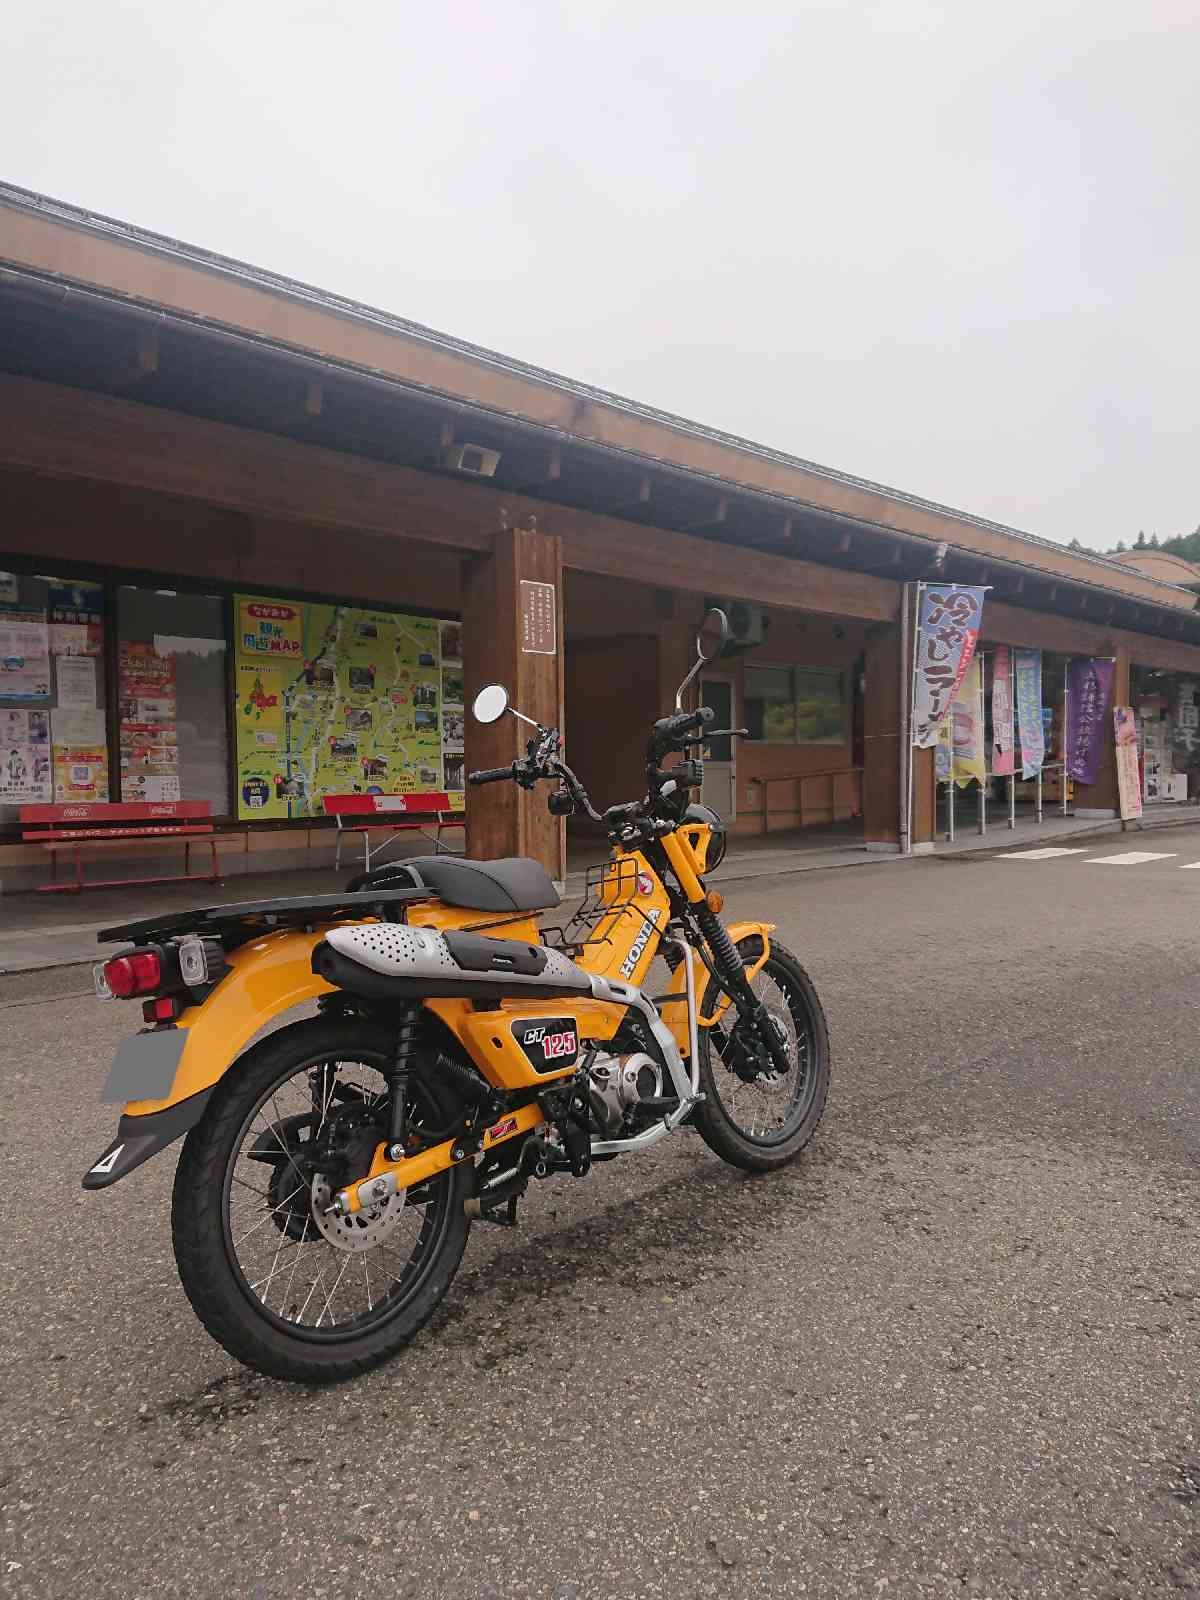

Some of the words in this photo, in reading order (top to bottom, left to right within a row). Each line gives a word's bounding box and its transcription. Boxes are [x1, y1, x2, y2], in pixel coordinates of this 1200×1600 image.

[620, 908, 661, 978] HONDA
[523, 1027, 546, 1046] CT
[541, 1031, 577, 1060] 125
